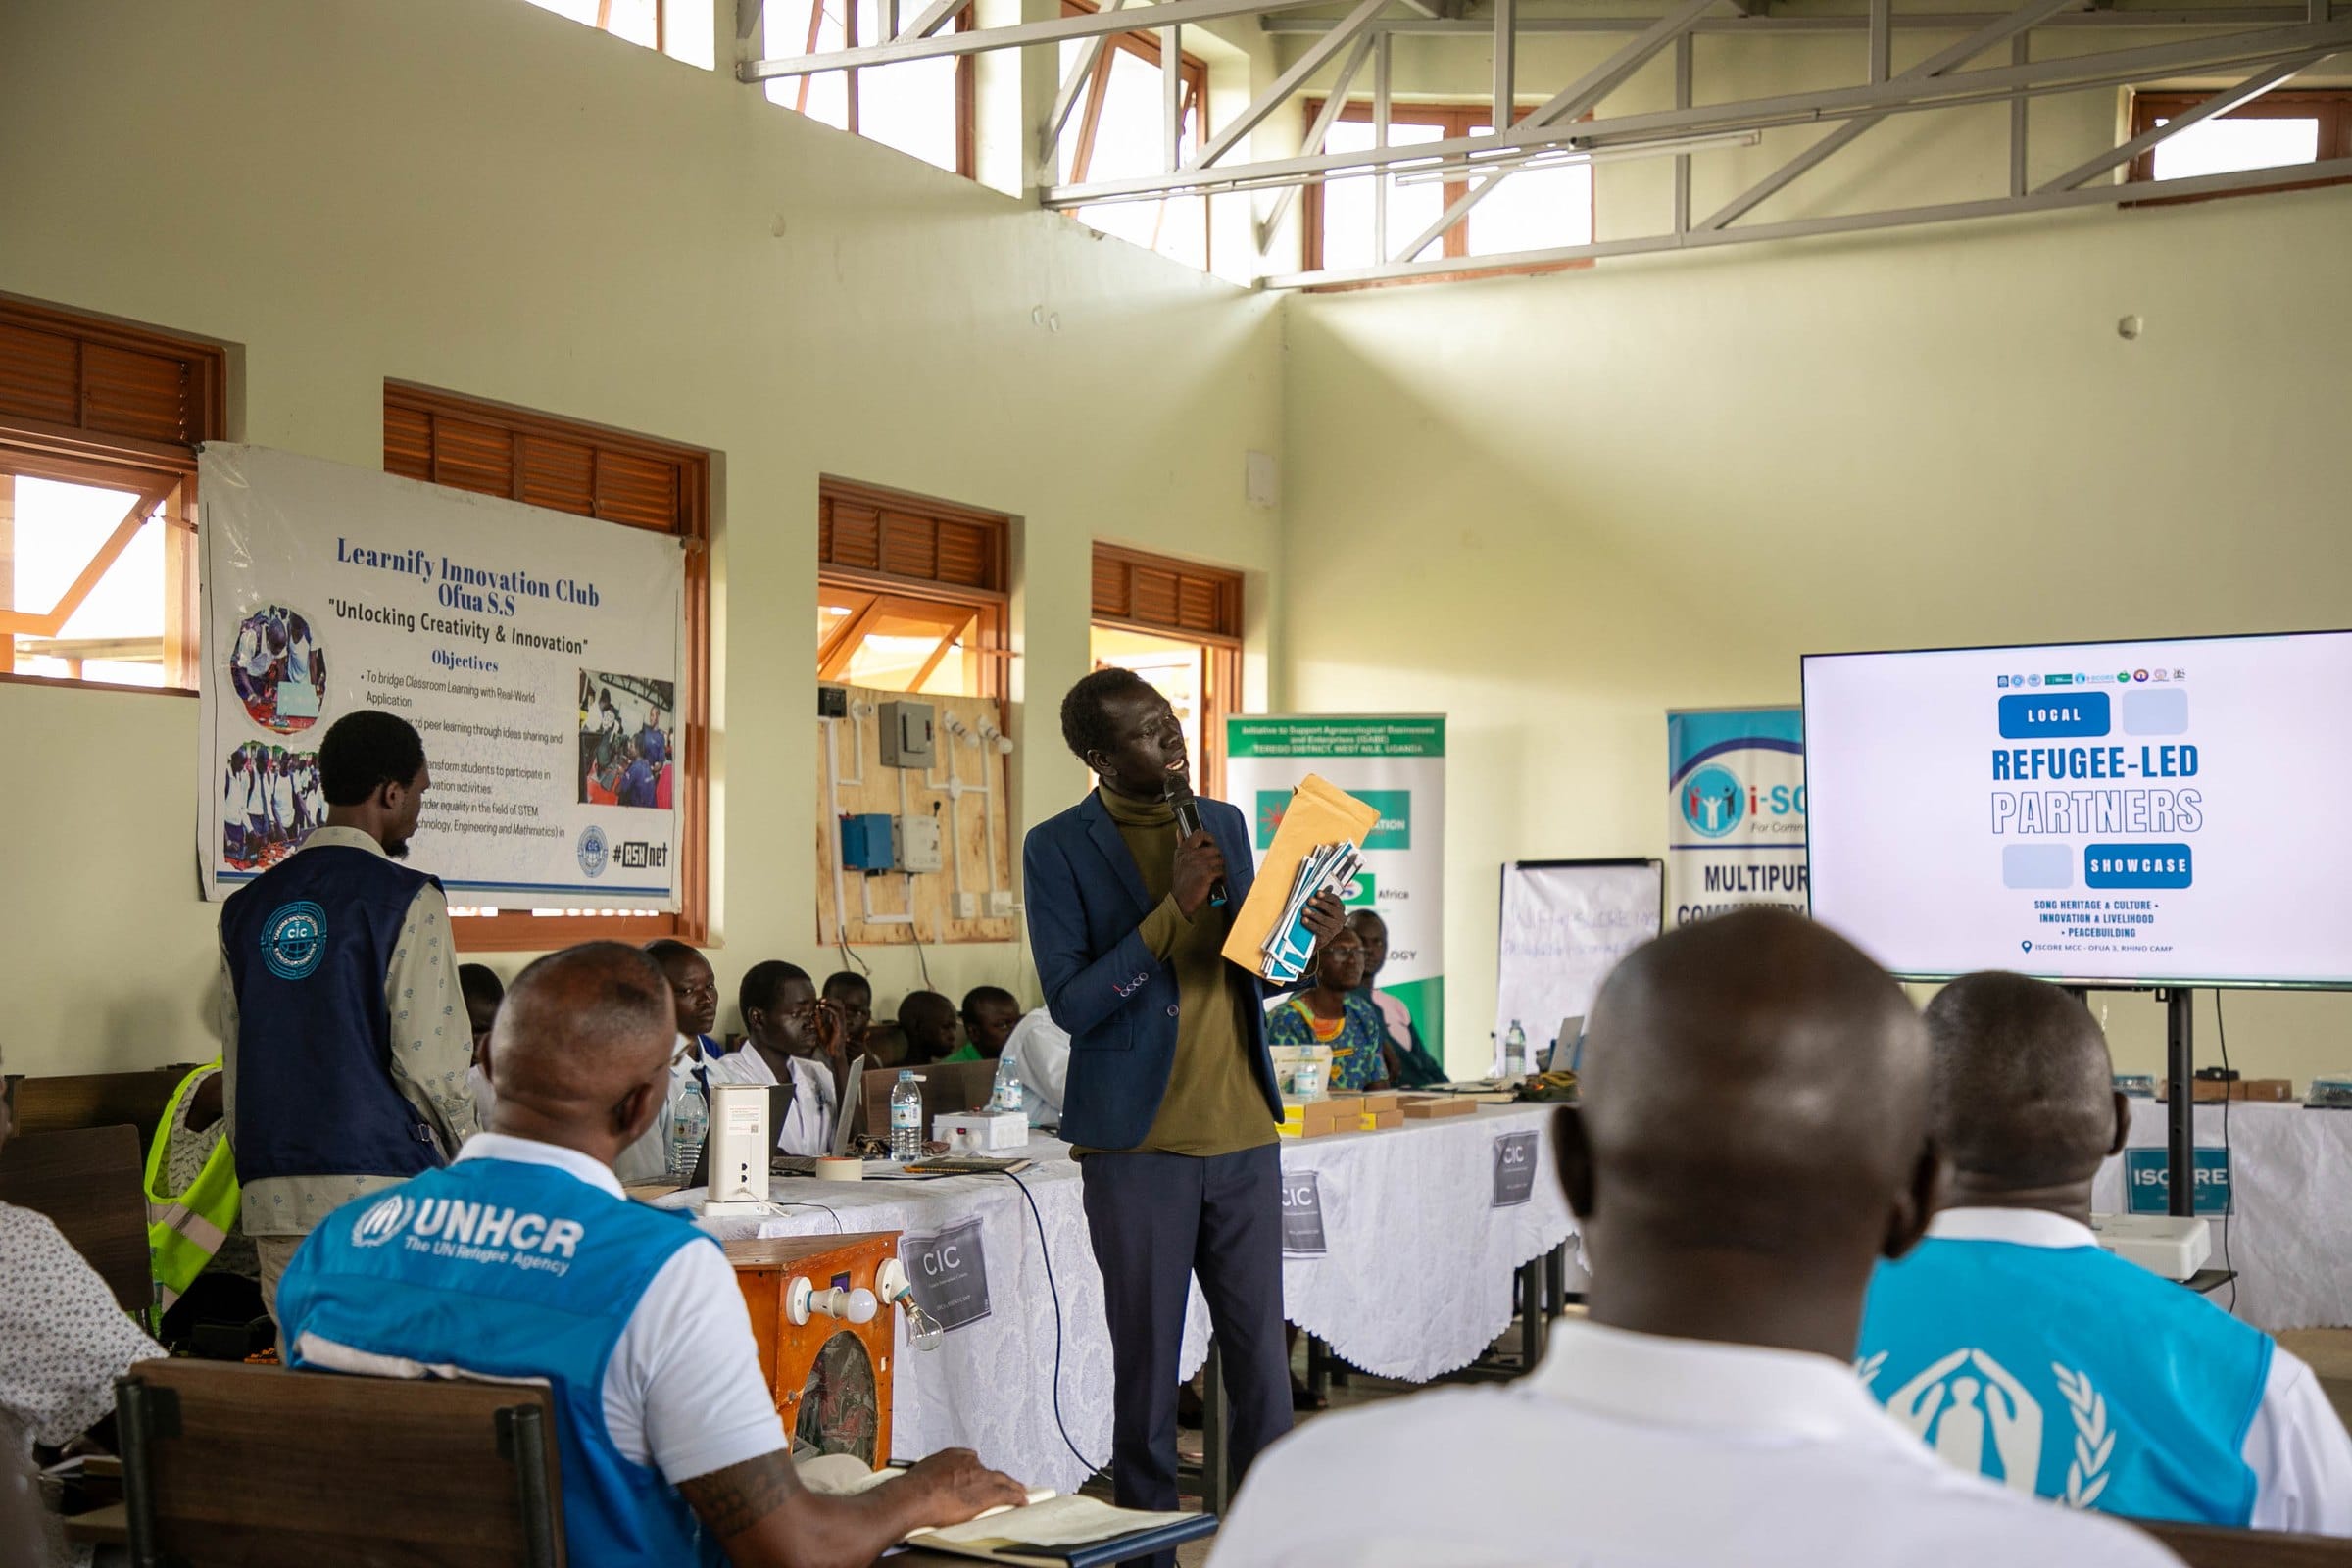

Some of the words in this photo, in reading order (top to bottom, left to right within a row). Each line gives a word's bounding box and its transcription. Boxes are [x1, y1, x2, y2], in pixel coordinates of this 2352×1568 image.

[337, 537, 435, 584] Learnify
[441, 557, 550, 598] Innovation
[556, 578, 600, 607] Club
[438, 583, 483, 612] Ofua
[487, 591, 515, 617] S.S
[328, 598, 416, 632] "Unlocking
[420, 612, 489, 644] Creativity
[495, 625, 507, 643] &
[512, 627, 588, 655] Innovation"
[431, 649, 500, 672] Objectives
[367, 670, 376, 684] To
[378, 672, 404, 688] bridge
[405, 675, 447, 692] Classroom
[447, 681, 479, 699] Learning
[480, 686, 496, 699] with
[497, 688, 536, 704] Real-World
[366, 691, 413, 708] Application
[2028, 708, 2081, 723] LOCAL
[415, 717, 423, 729] to
[423, 720, 442, 731] peer
[443, 719, 473, 736] learning
[473, 723, 502, 738] through
[502, 727, 522, 740] ideas
[522, 729, 549, 745] sharing
[550, 731, 564, 744] and
[427, 759, 460, 771] ansform
[461, 762, 497, 775] students
[496, 765, 504, 776] to
[505, 767, 541, 781] participate
[544, 769, 551, 780] in
[1992, 745, 2198, 780] REFUGEE-LED
[431, 781, 456, 791] vation
[421, 800, 439, 809] nder
[441, 801, 470, 813] equality
[478, 802, 490, 812] the
[492, 803, 508, 814] field
[509, 804, 517, 815] of
[517, 805, 539, 816] STEM
[1991, 788, 2203, 834] PARTNERS
[454, 819, 498, 836] Engineering
[498, 824, 513, 834] and
[559, 828, 565, 838] in
[1750, 823, 1769, 833] For
[2090, 858, 2186, 873] SHOWCASE
[1705, 865, 1808, 892] MULTIPUR
[1378, 890, 1410, 900] Africa
[2034, 900, 2057, 909] SONG
[2060, 900, 2102, 909] HERITAGE
[2114, 900, 2152, 910] CULTURE
[2039, 913, 2091, 924] INNOVATION
[2103, 913, 2154, 924] LIVELIHOOD
[2068, 927, 2136, 938] PEACEBUILDING
[1503, 1145, 1525, 1164] CIC
[2134, 1167, 2229, 1186] ISCRE
[414, 1198, 585, 1258] UNHCR
[405, 1235, 431, 1253] The
[433, 1242, 454, 1258] UN
[457, 1246, 509, 1264] Refugee
[511, 1251, 571, 1278] Agency
[923, 1246, 960, 1275] CIC
